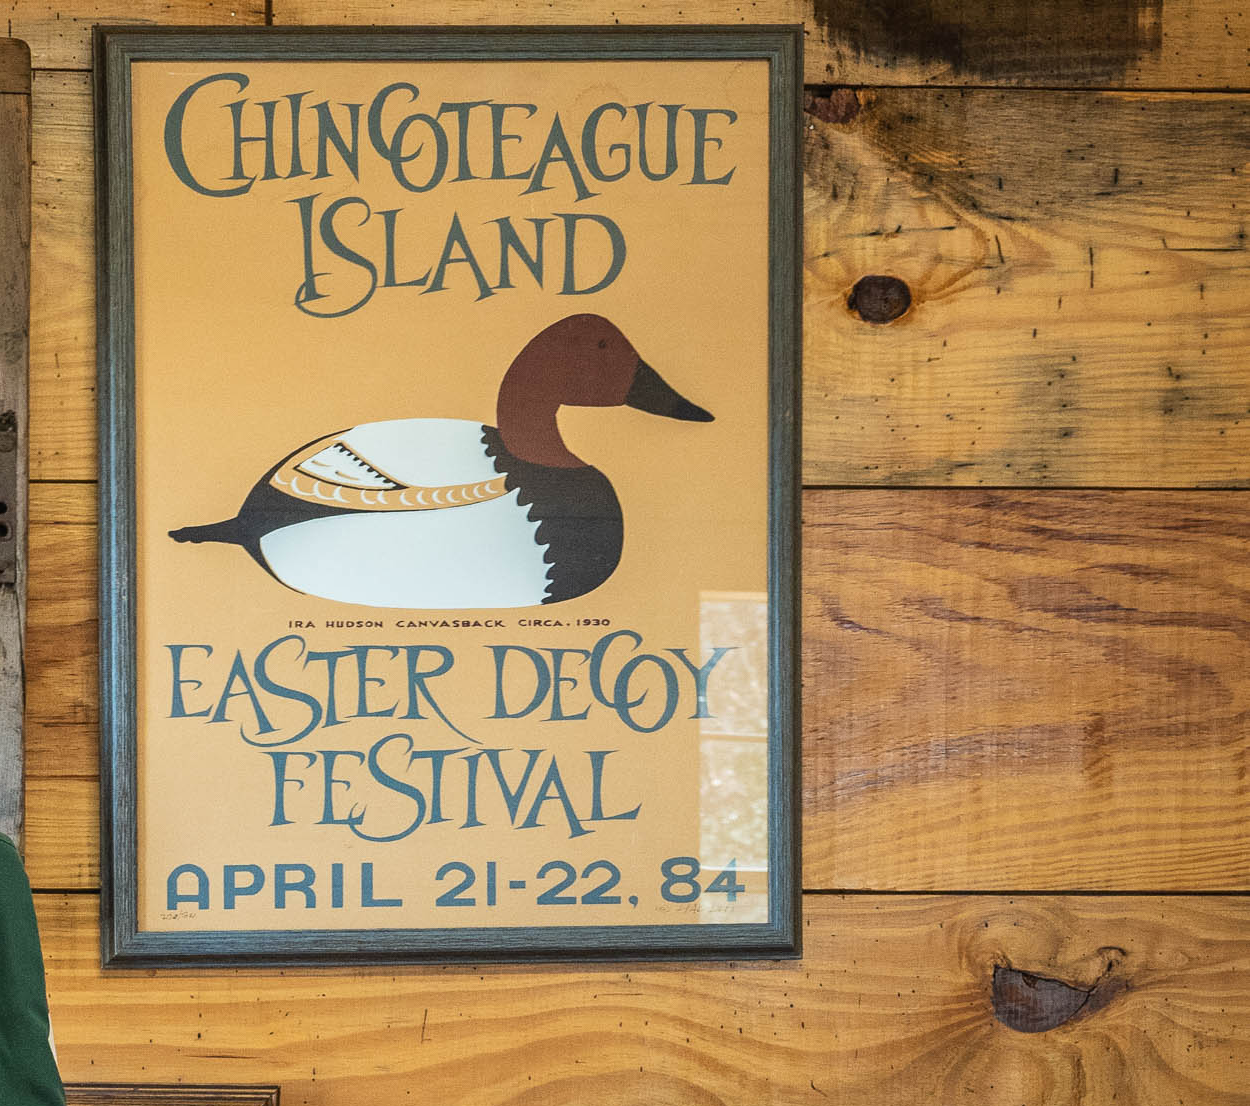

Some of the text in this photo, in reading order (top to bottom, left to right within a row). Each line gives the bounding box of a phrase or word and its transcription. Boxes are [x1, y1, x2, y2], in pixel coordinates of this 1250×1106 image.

[163, 72, 738, 202] CHINCOTEAGUE
[285, 193, 627, 319] ISLAND
[288, 620, 316, 629] IRA
[325, 620, 383, 628] HUDSON
[395, 619, 506, 628] CANVASBACK
[576, 618, 611, 626] 1930
[163, 629, 740, 748] EASTER DECOY
[262, 732, 643, 843] FESTIVAL
[166, 855, 747, 911] APRIL 21-22, 84
